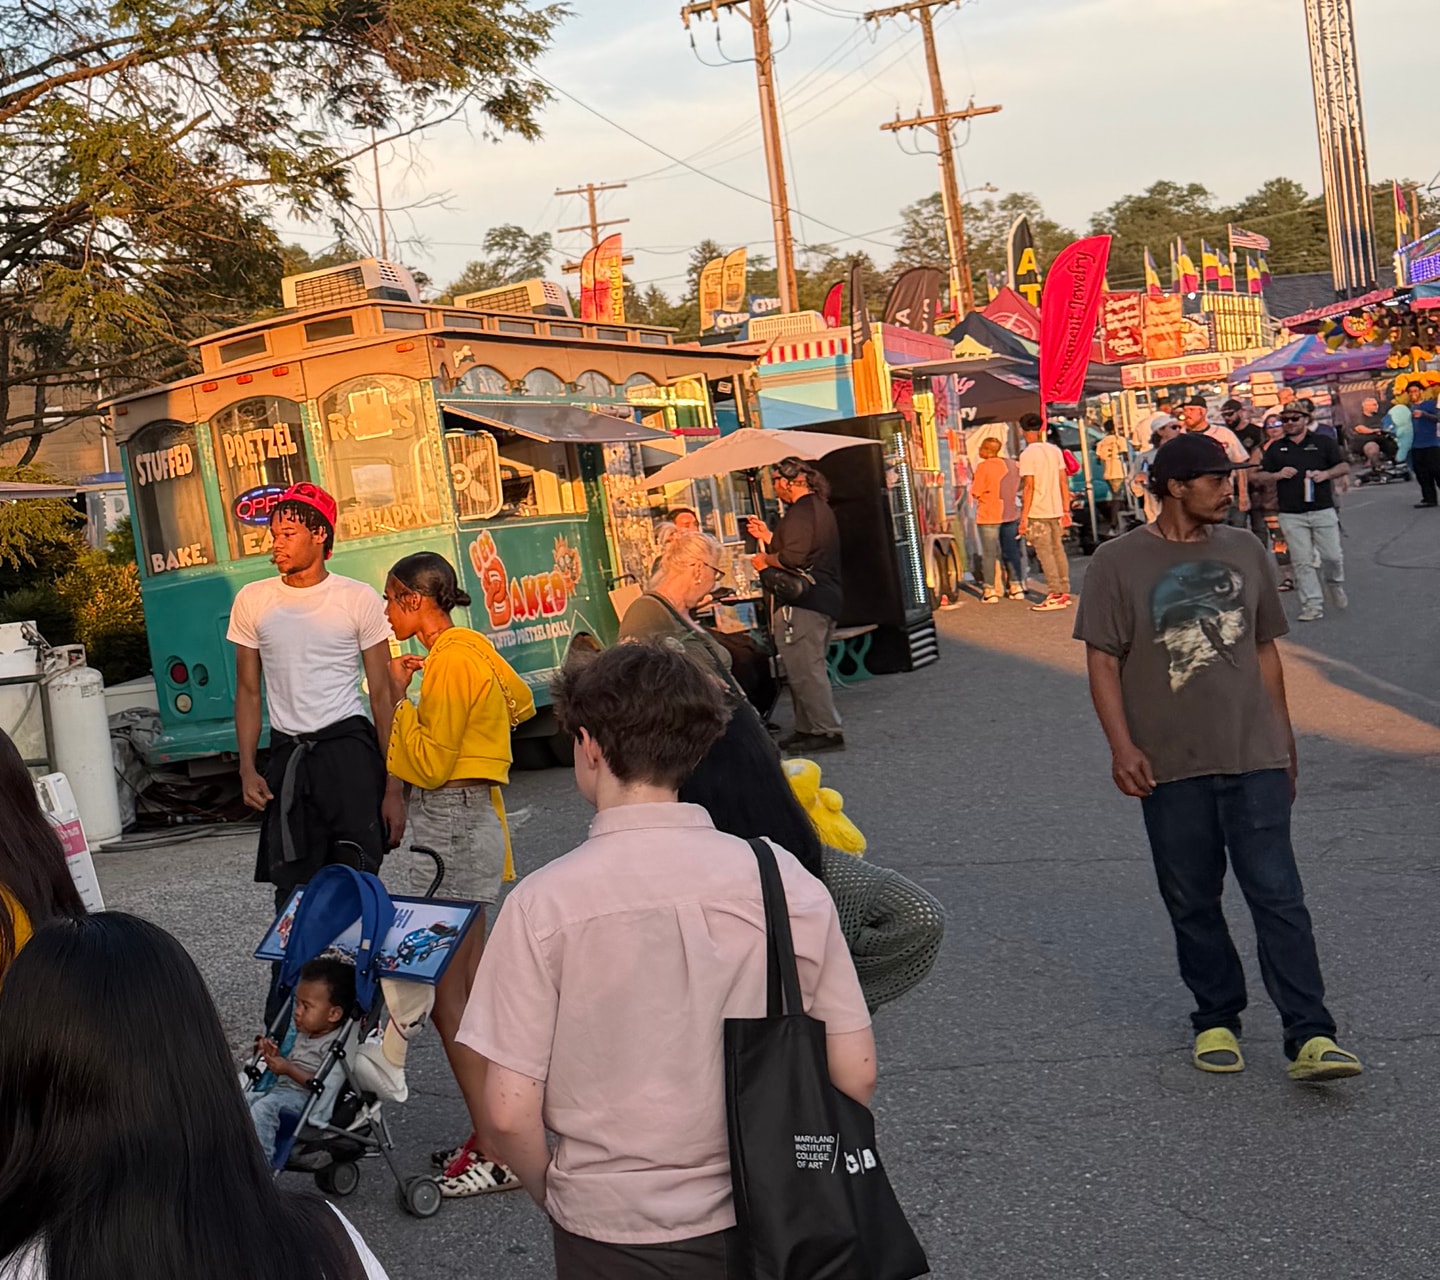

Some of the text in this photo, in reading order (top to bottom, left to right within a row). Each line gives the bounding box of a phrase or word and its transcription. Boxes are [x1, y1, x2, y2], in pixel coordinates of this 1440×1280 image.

[1017, 247, 1042, 307] AT
[135, 443, 194, 487] STUFFED
[222, 422, 298, 468] PRETZEL
[236, 494, 282, 518] OPE
[151, 543, 208, 573] BAKE.
[242, 529, 274, 555] EA
[481, 555, 568, 629] BAKED
[794, 1135, 835, 1144] MARYLAND
[795, 1144, 832, 1152] INSTITUTE
[796, 1152, 830, 1161] COLLEGE
[796, 1161, 823, 1169] OF ART
